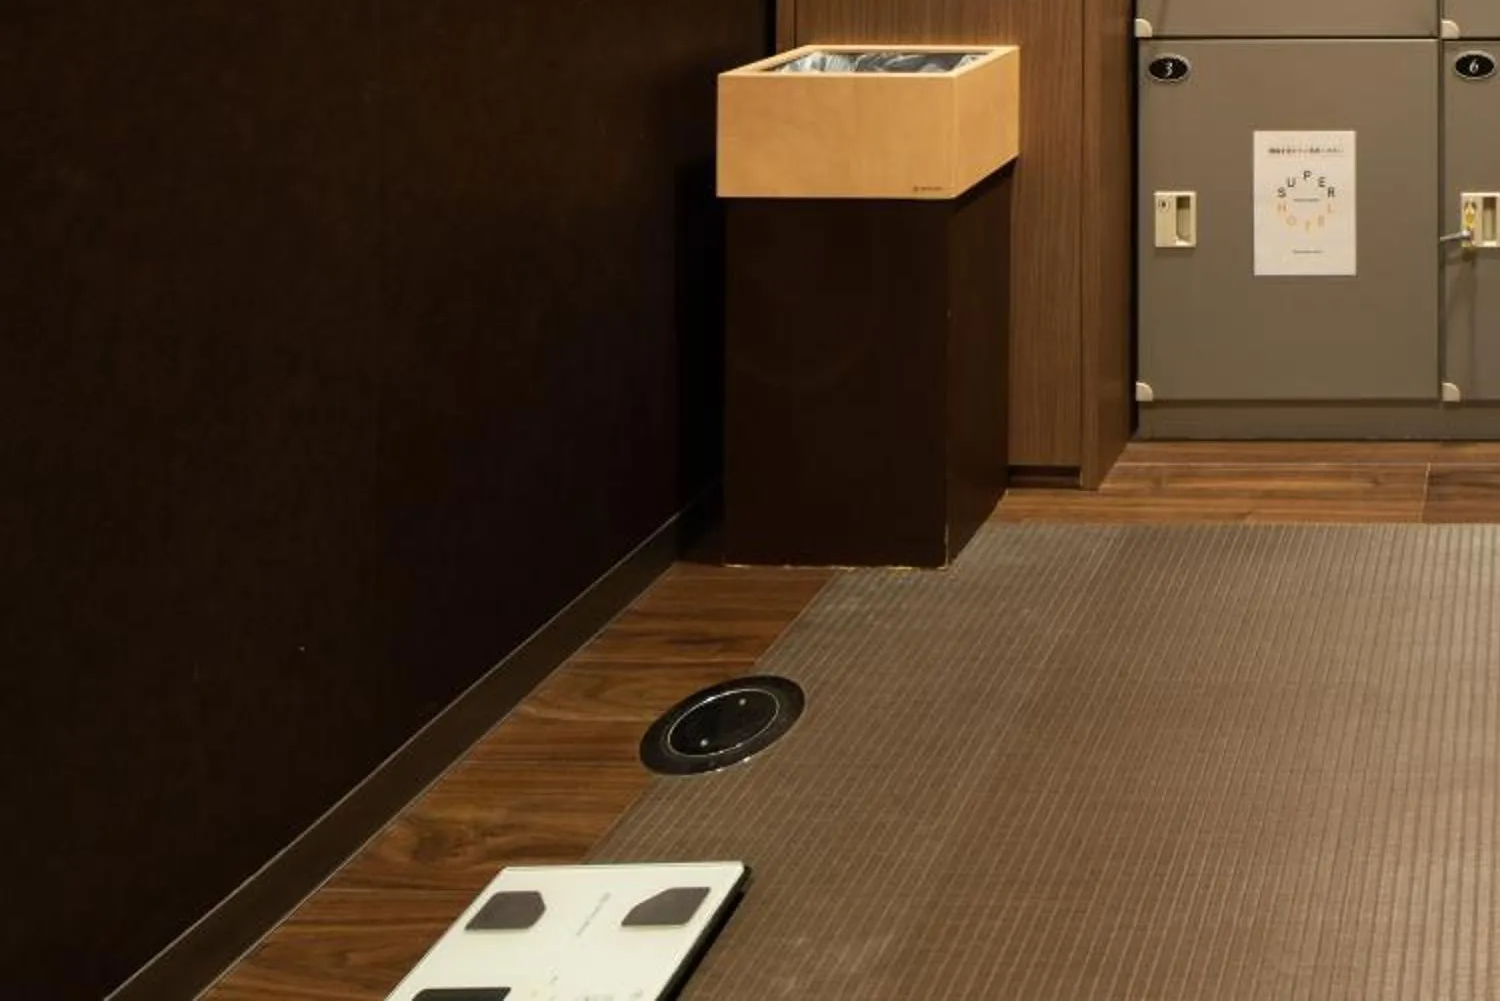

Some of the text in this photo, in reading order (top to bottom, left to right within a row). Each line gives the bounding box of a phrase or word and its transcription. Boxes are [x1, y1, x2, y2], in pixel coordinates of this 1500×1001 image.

[1164, 62, 1173, 76] 3
[1469, 60, 1479, 74] 6
[1277, 170, 1335, 198] SUPER
